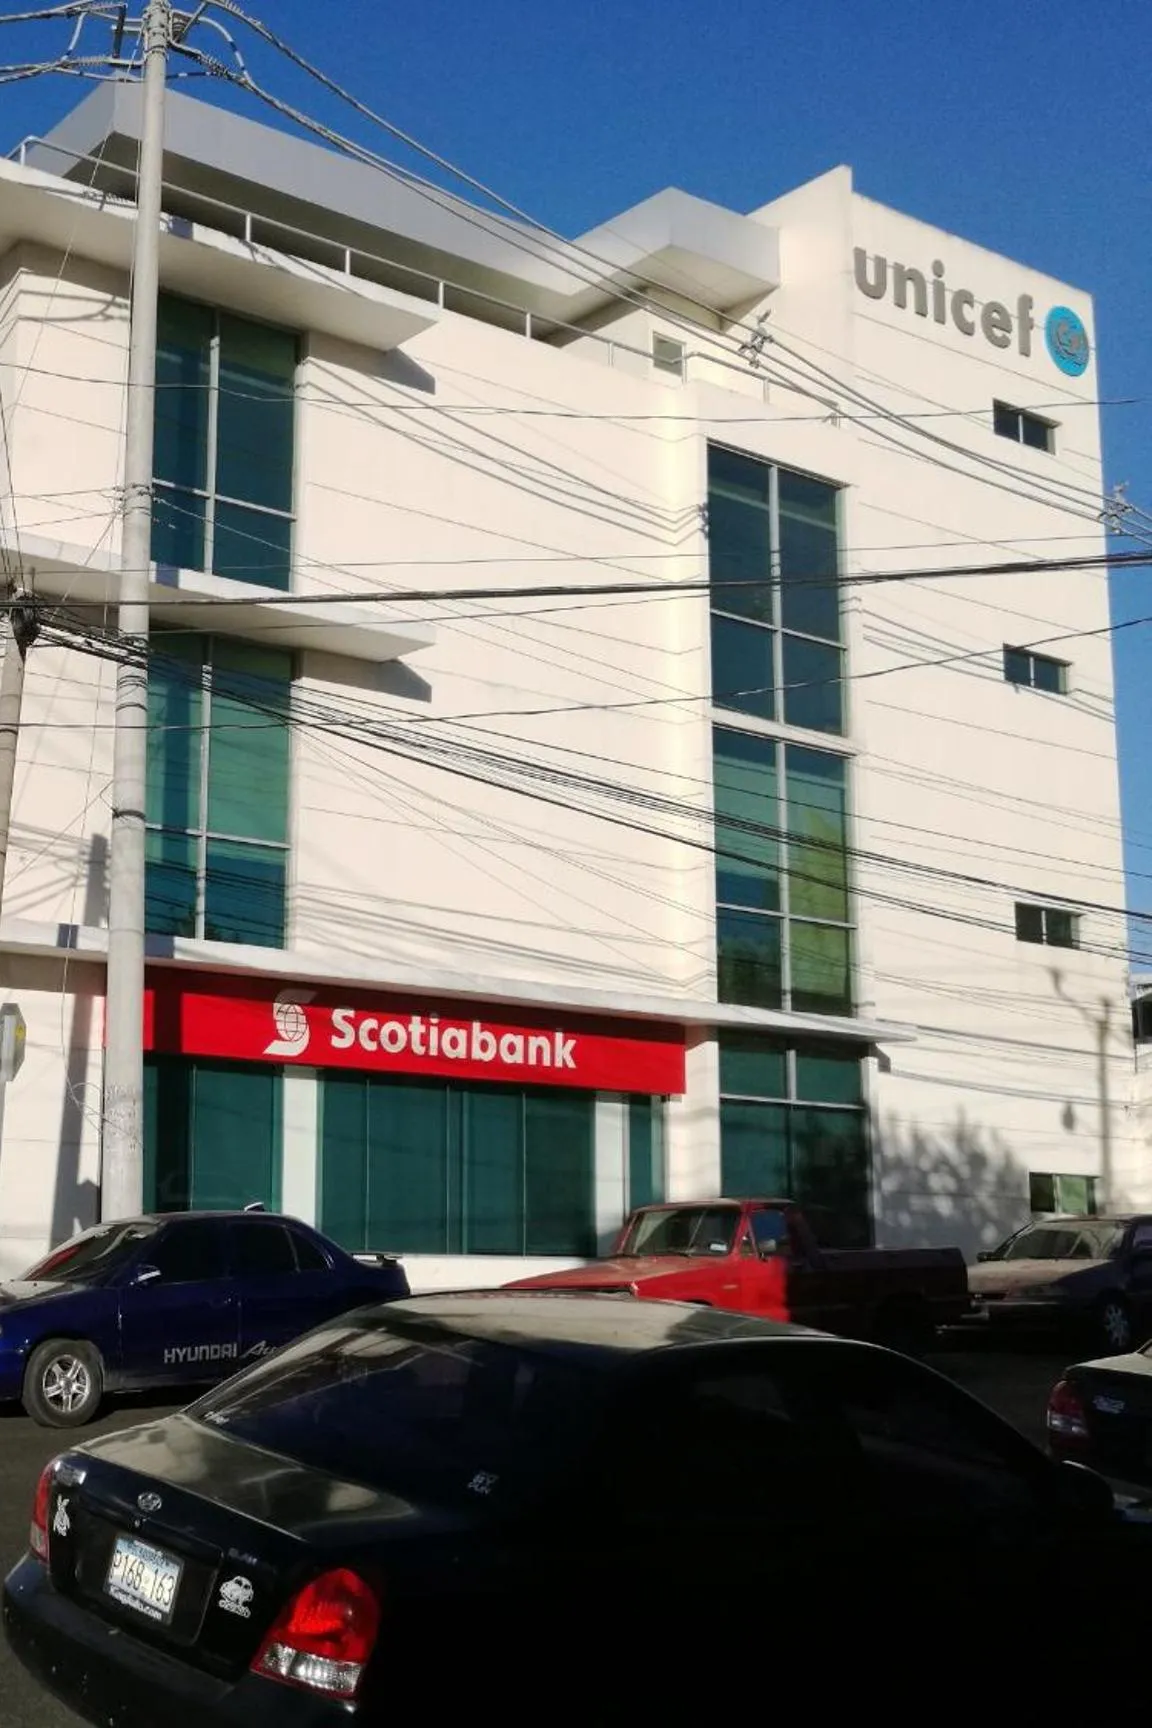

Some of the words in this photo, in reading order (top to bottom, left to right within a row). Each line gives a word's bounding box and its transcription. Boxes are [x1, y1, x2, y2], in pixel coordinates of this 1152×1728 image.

[853, 246, 1035, 358] unicef
[330, 1006, 578, 1069] Scotiabank
[163, 1342, 238, 1364] HYUNDAI
